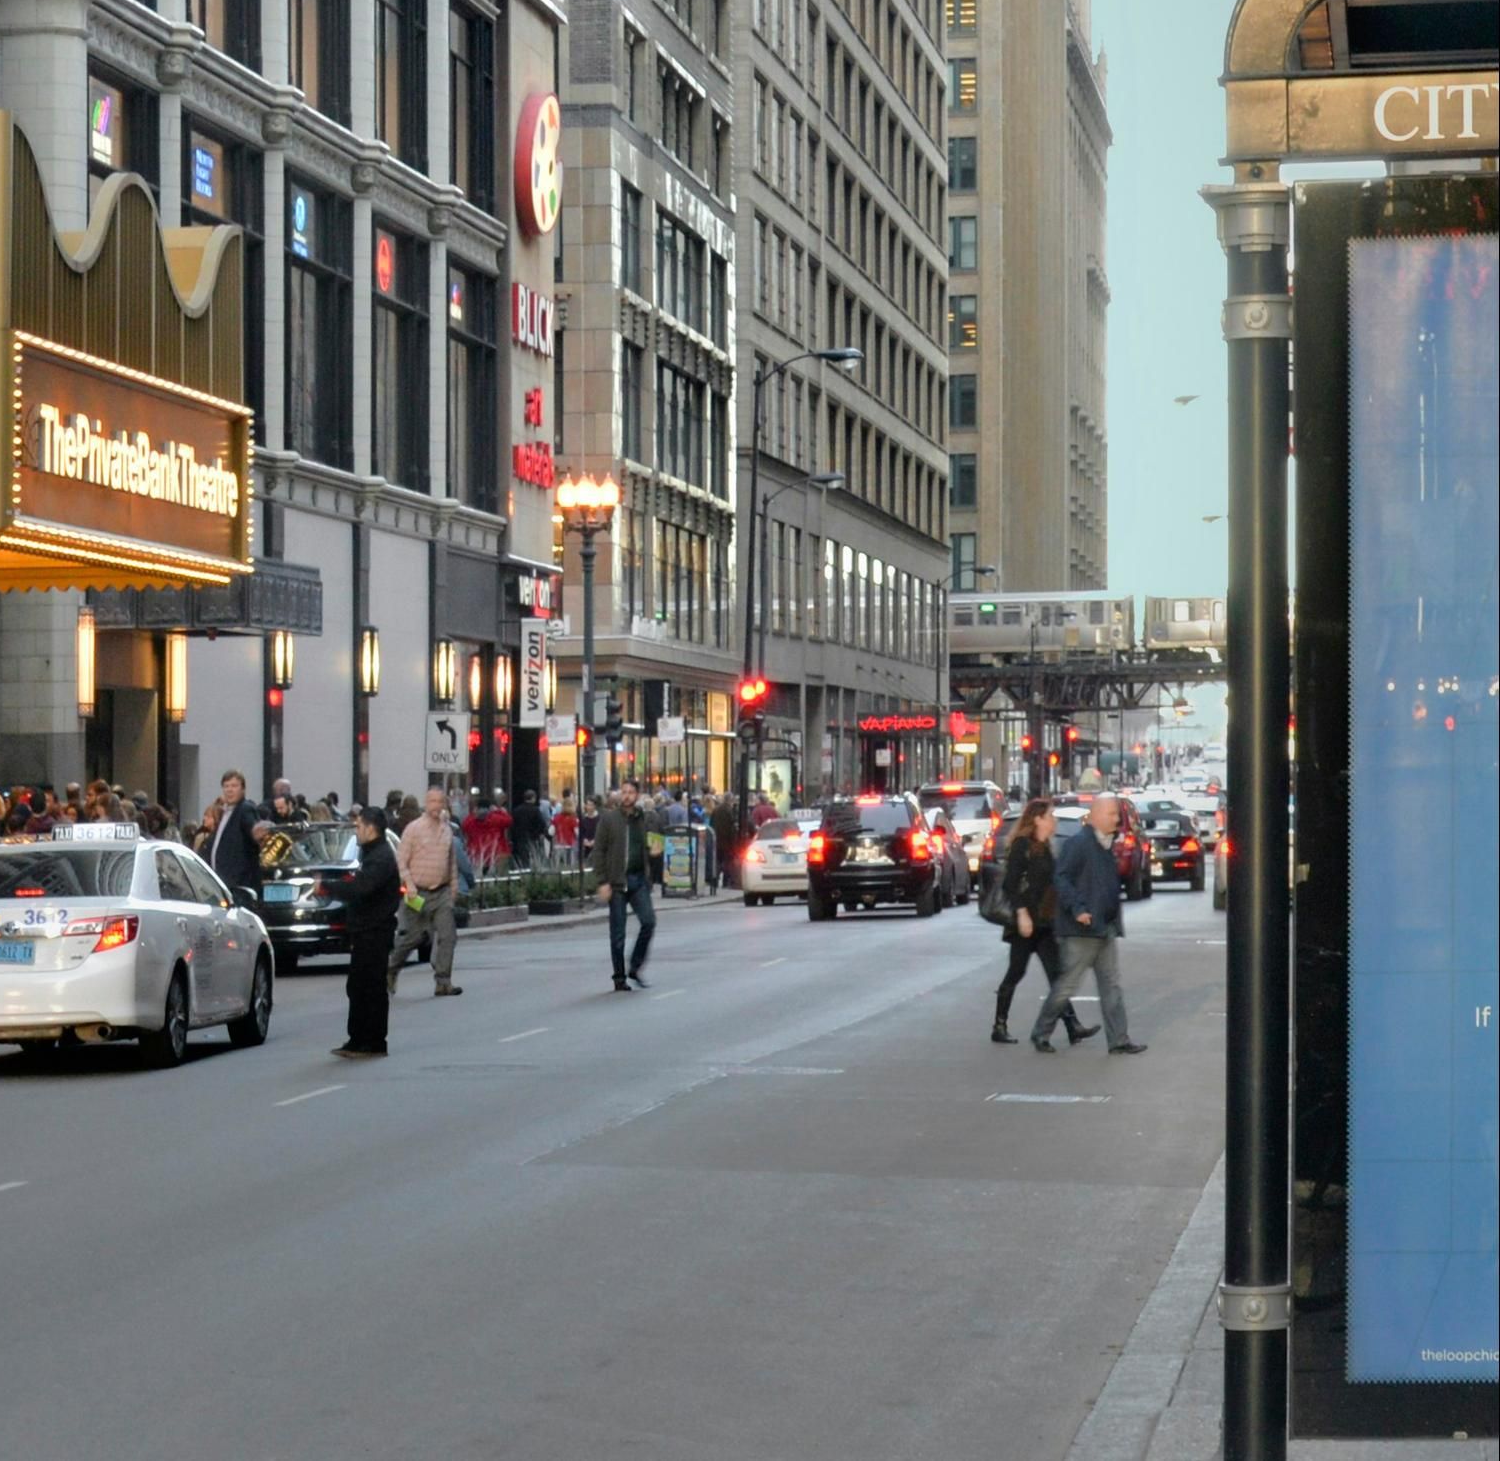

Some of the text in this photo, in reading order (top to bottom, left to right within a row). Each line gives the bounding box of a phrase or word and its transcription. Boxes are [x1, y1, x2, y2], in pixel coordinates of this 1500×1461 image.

[1374, 83, 1498, 142] CIT
[514, 283, 554, 357] BLICK
[40, 403, 239, 518] The PrivateBank Theatre
[524, 631, 545, 712] verizon
[432, 752, 459, 764] ONLY
[54, 826, 73, 841] TAXI
[115, 824, 134, 839] TAXI
[1475, 1006, 1491, 1028] If
